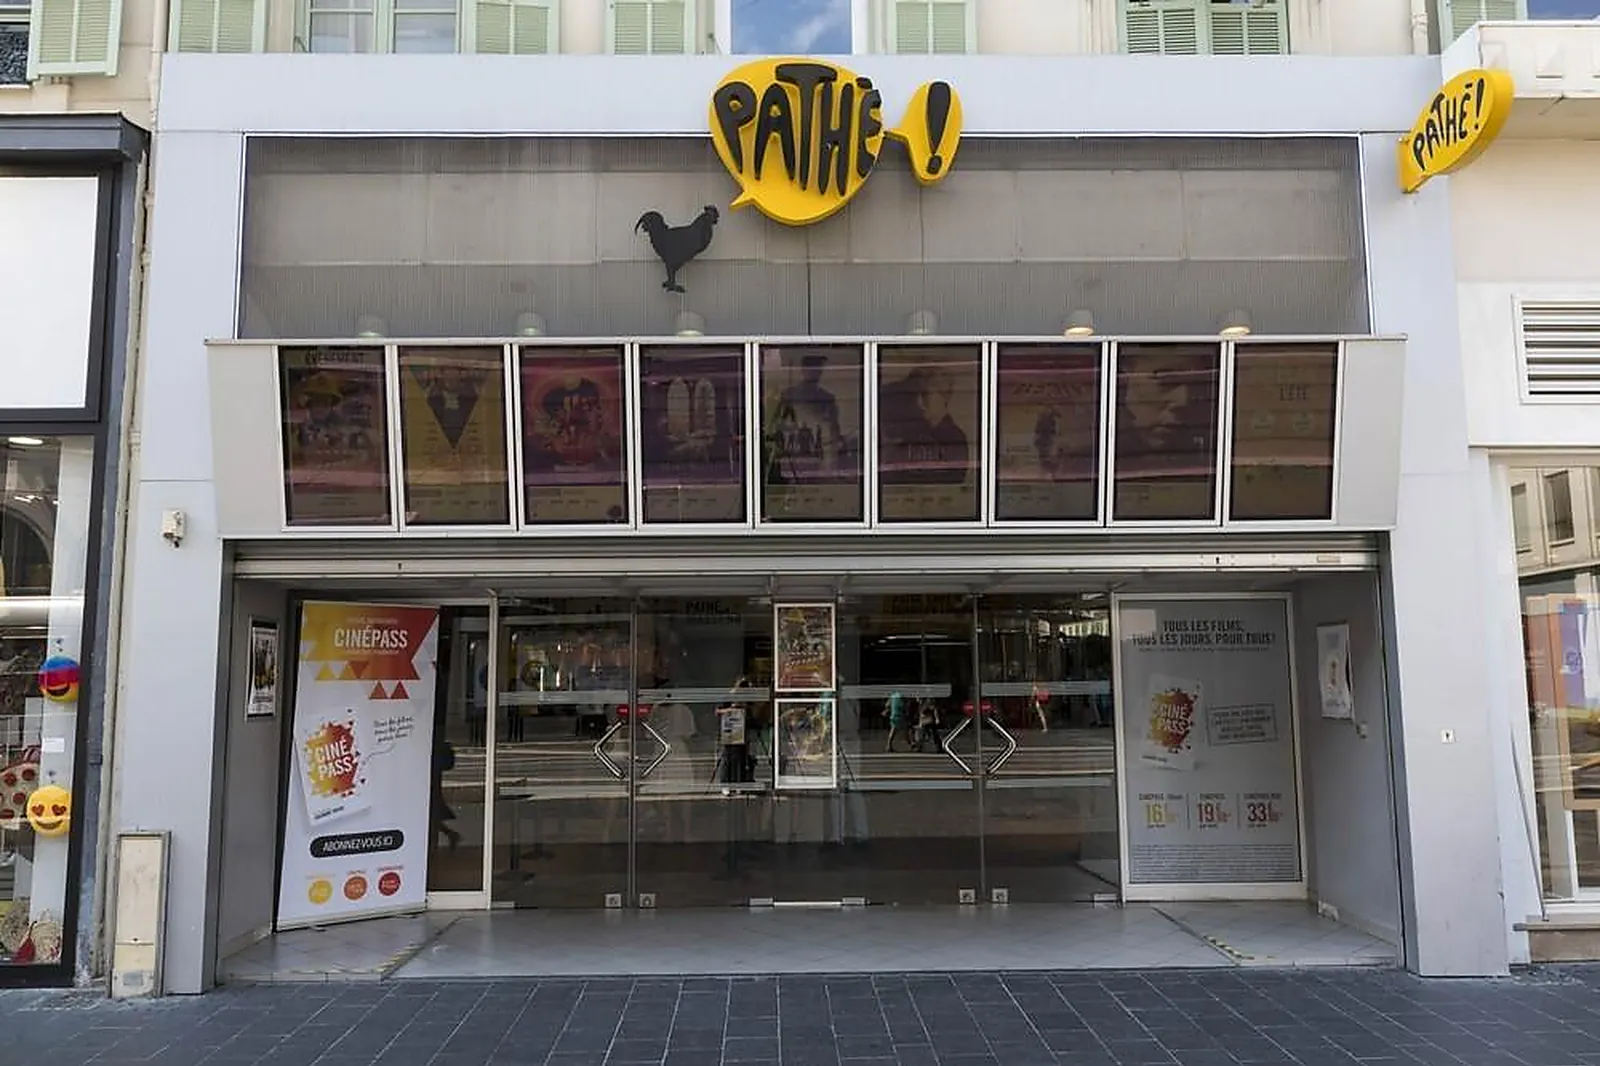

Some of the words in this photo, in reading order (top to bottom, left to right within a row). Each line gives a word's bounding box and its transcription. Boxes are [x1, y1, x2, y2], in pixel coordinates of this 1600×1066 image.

[713, 63, 883, 196] PATHÉ
[334, 625, 408, 648] CINÉPASS
[315, 736, 349, 763] CINÉ
[318, 756, 353, 780] PASS
